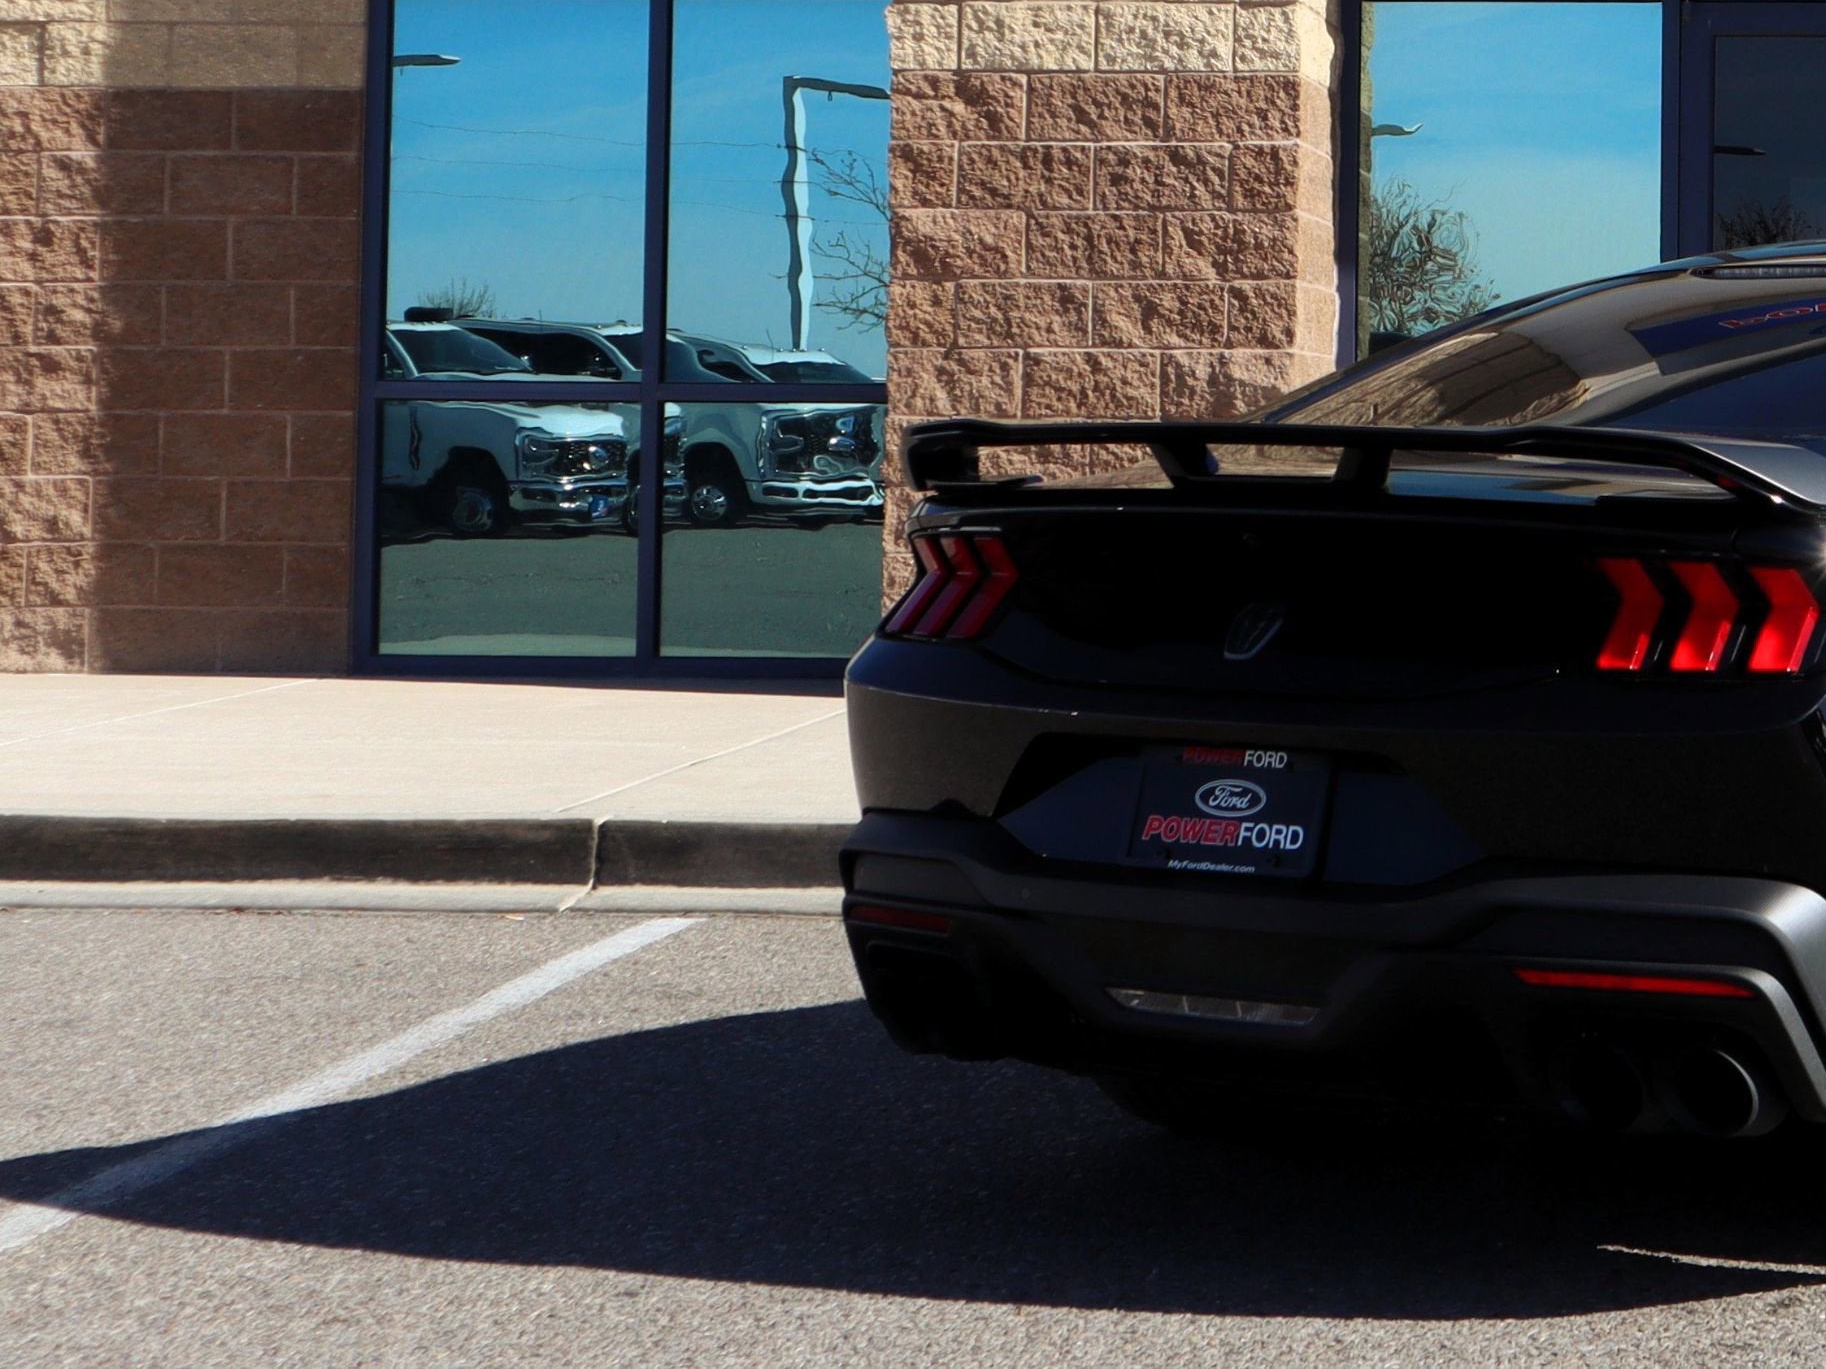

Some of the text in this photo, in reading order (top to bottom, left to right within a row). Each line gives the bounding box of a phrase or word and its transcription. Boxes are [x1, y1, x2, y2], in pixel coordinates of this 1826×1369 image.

[1208, 785, 1251, 809] Ford
[1142, 815, 1304, 850] POWERFORD
[1167, 859, 1255, 873] MyFordDealer.com
